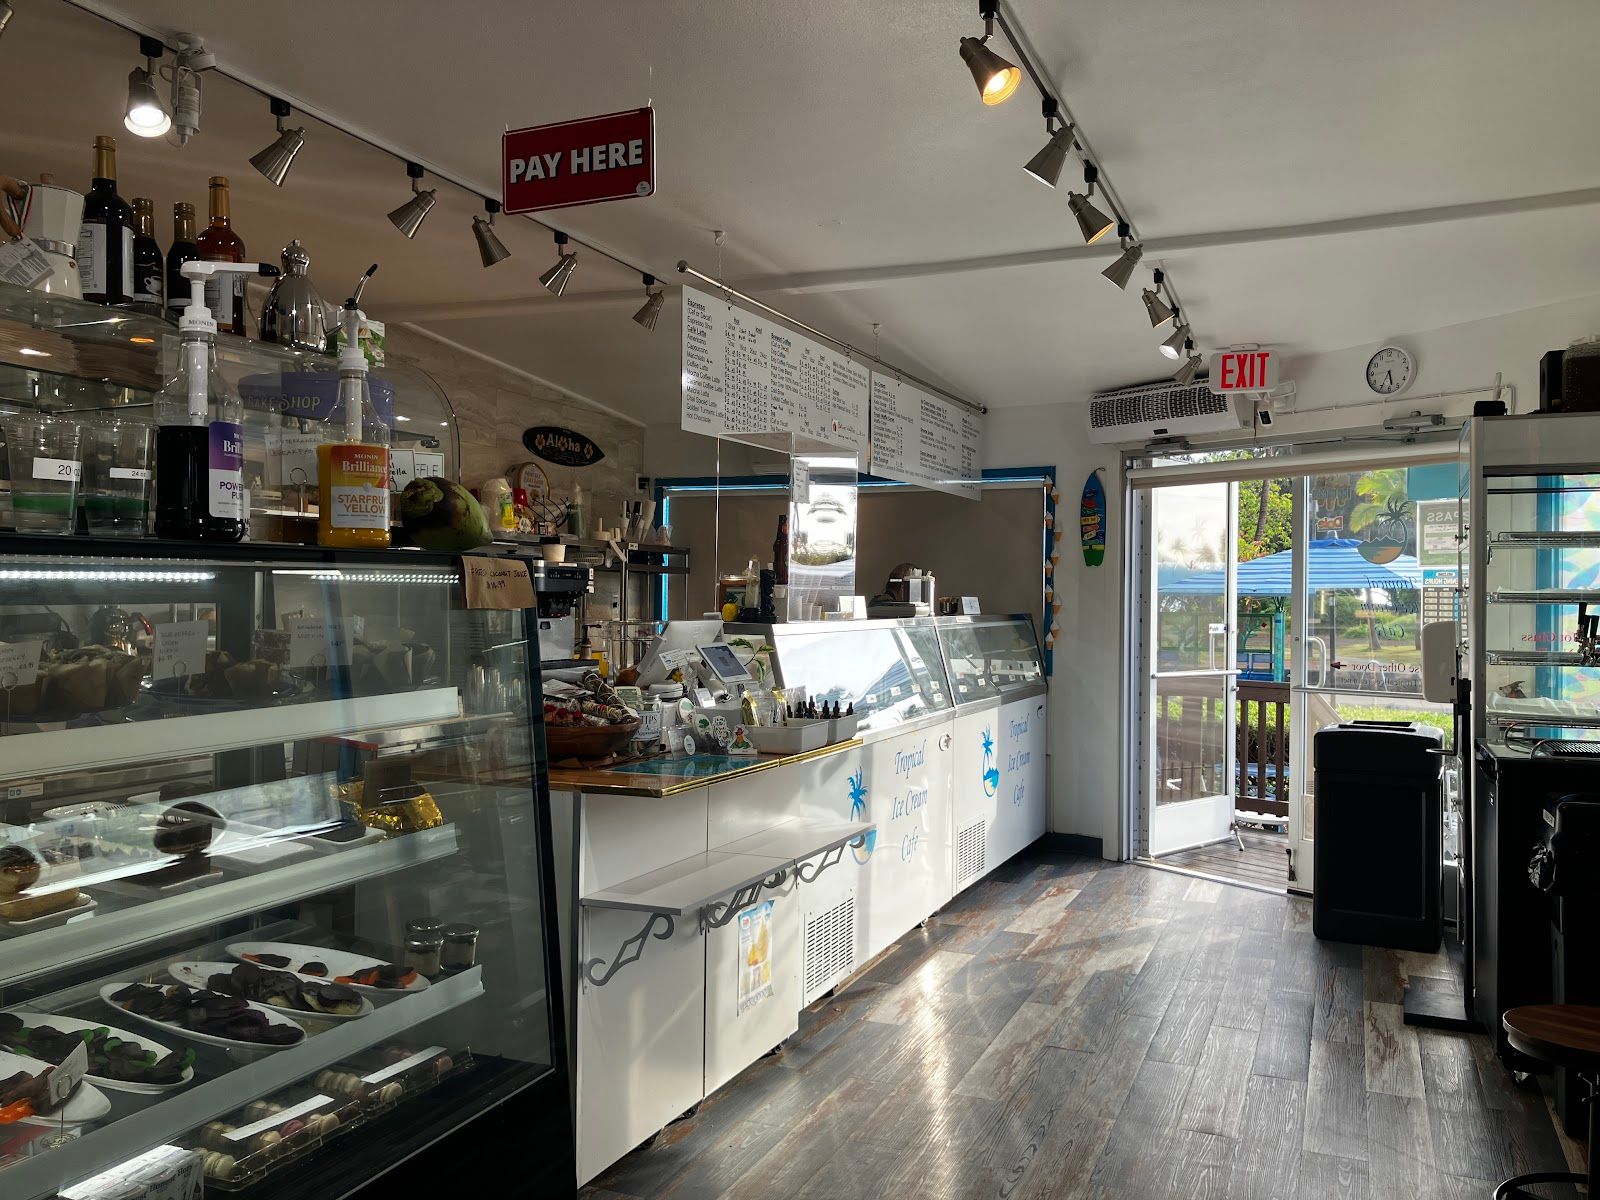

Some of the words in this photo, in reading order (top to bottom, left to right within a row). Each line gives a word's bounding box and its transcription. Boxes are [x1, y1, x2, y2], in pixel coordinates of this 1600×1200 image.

[510, 152, 562, 184] PAY
[570, 138, 643, 175] HERE
[687, 298, 705, 312] Espresso
[188, 319, 215, 328] MONIN
[687, 315, 704, 328] Espresso
[1221, 352, 1270, 389] EXIT
[278, 393, 321, 412] SHOP
[546, 433, 581, 453] Aloha
[58, 465, 72, 475] 20
[1009, 714, 1030, 742] Tropical
[894, 739, 927, 779] Tropical
[1008, 754, 1016, 773] Ice
[1016, 751, 1031, 771] Cream
[891, 797, 905, 821] Ice
[906, 788, 928, 816] Cream
